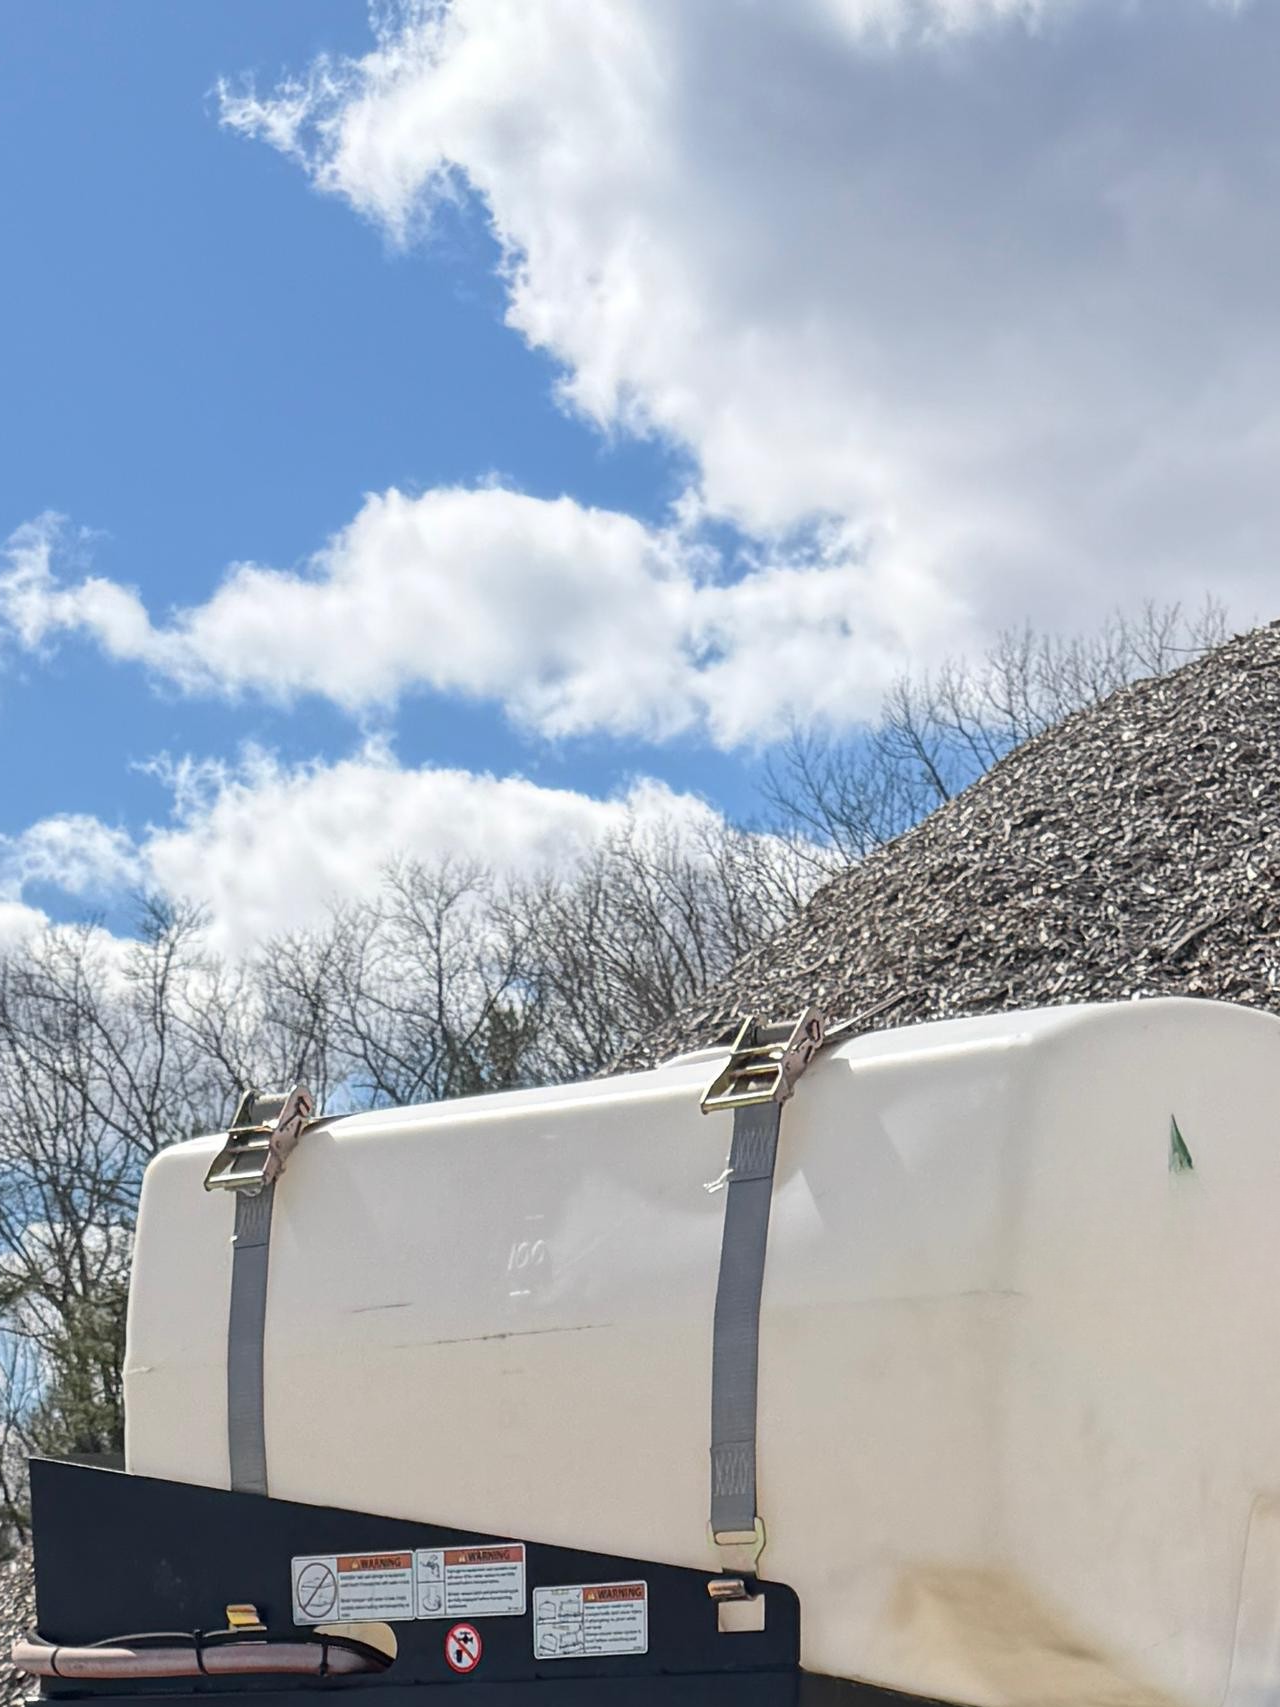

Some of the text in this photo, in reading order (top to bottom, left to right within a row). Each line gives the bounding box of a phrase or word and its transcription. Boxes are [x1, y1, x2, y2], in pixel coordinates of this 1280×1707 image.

[467, 1550, 510, 1562] WARNING
[360, 1557, 402, 1569] WARNING
[596, 1587, 642, 1599] WARNING
